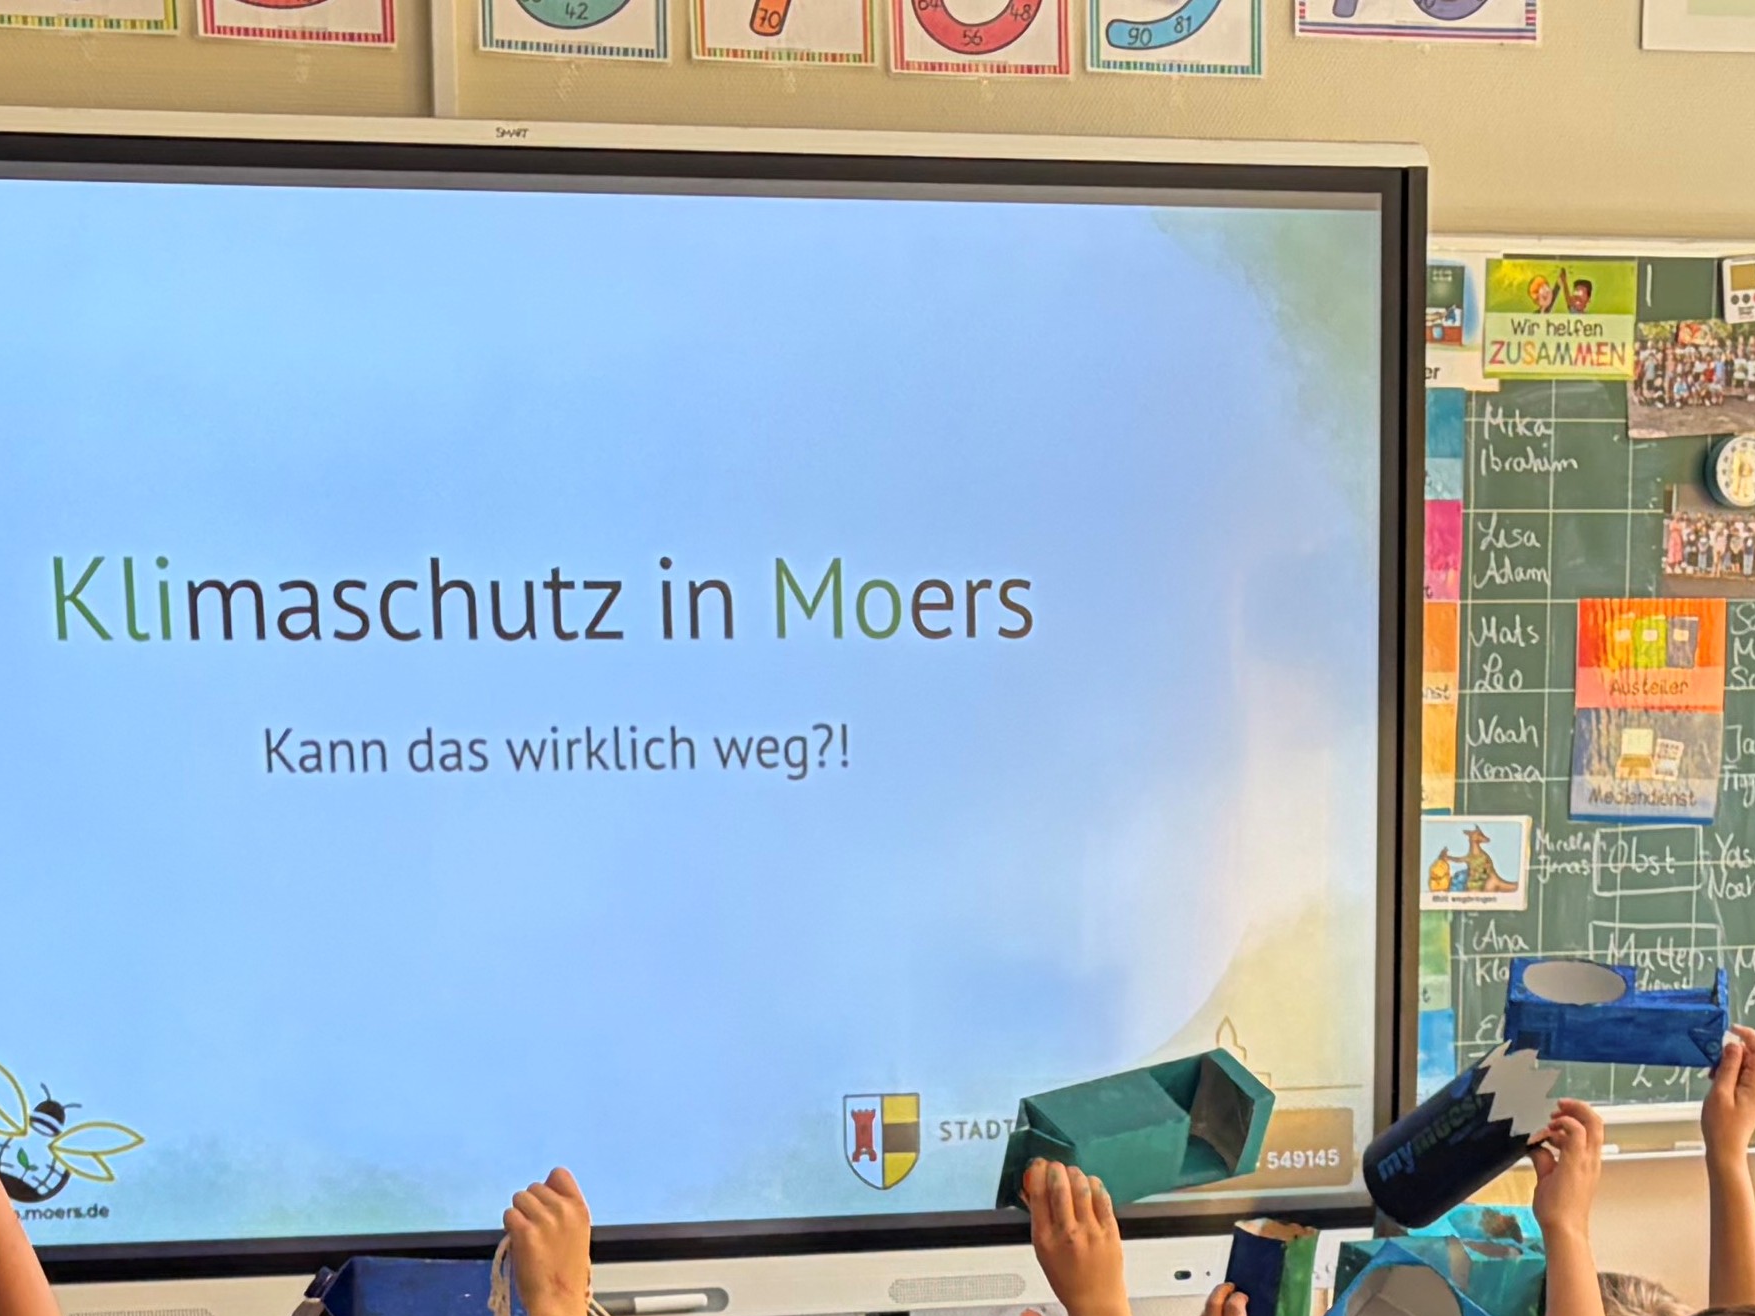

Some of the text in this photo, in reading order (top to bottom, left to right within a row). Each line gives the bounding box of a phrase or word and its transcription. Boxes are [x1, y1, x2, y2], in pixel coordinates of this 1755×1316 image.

[564, 2, 589, 21] 42
[756, 9, 783, 28] 70
[961, 29, 985, 46] 56
[1009, 3, 1033, 22] 48
[1128, 15, 1193, 46] 90 81
[495, 126, 530, 139] SMART
[1510, 317, 1604, 337] Wir helfen
[1488, 341, 1627, 368] ZUSAMMEN
[1483, 400, 1552, 439] Mika
[1480, 447, 1578, 477] Ibrahim
[1478, 513, 1541, 549] Lisa
[1472, 557, 1551, 590] Adam
[52, 555, 1035, 642] Klimaschutz in Moers
[1474, 653, 1524, 692] Leo
[1608, 678, 1689, 697] Austeiler
[1466, 716, 1541, 749] Noah
[263, 722, 852, 781] Kann das wirklich weg?!
[1587, 788, 1697, 808] Mediendienst
[1608, 842, 1676, 875] Obst
[940, 1119, 1017, 1142] STADT
[1266, 1148, 1340, 1170] 549145
